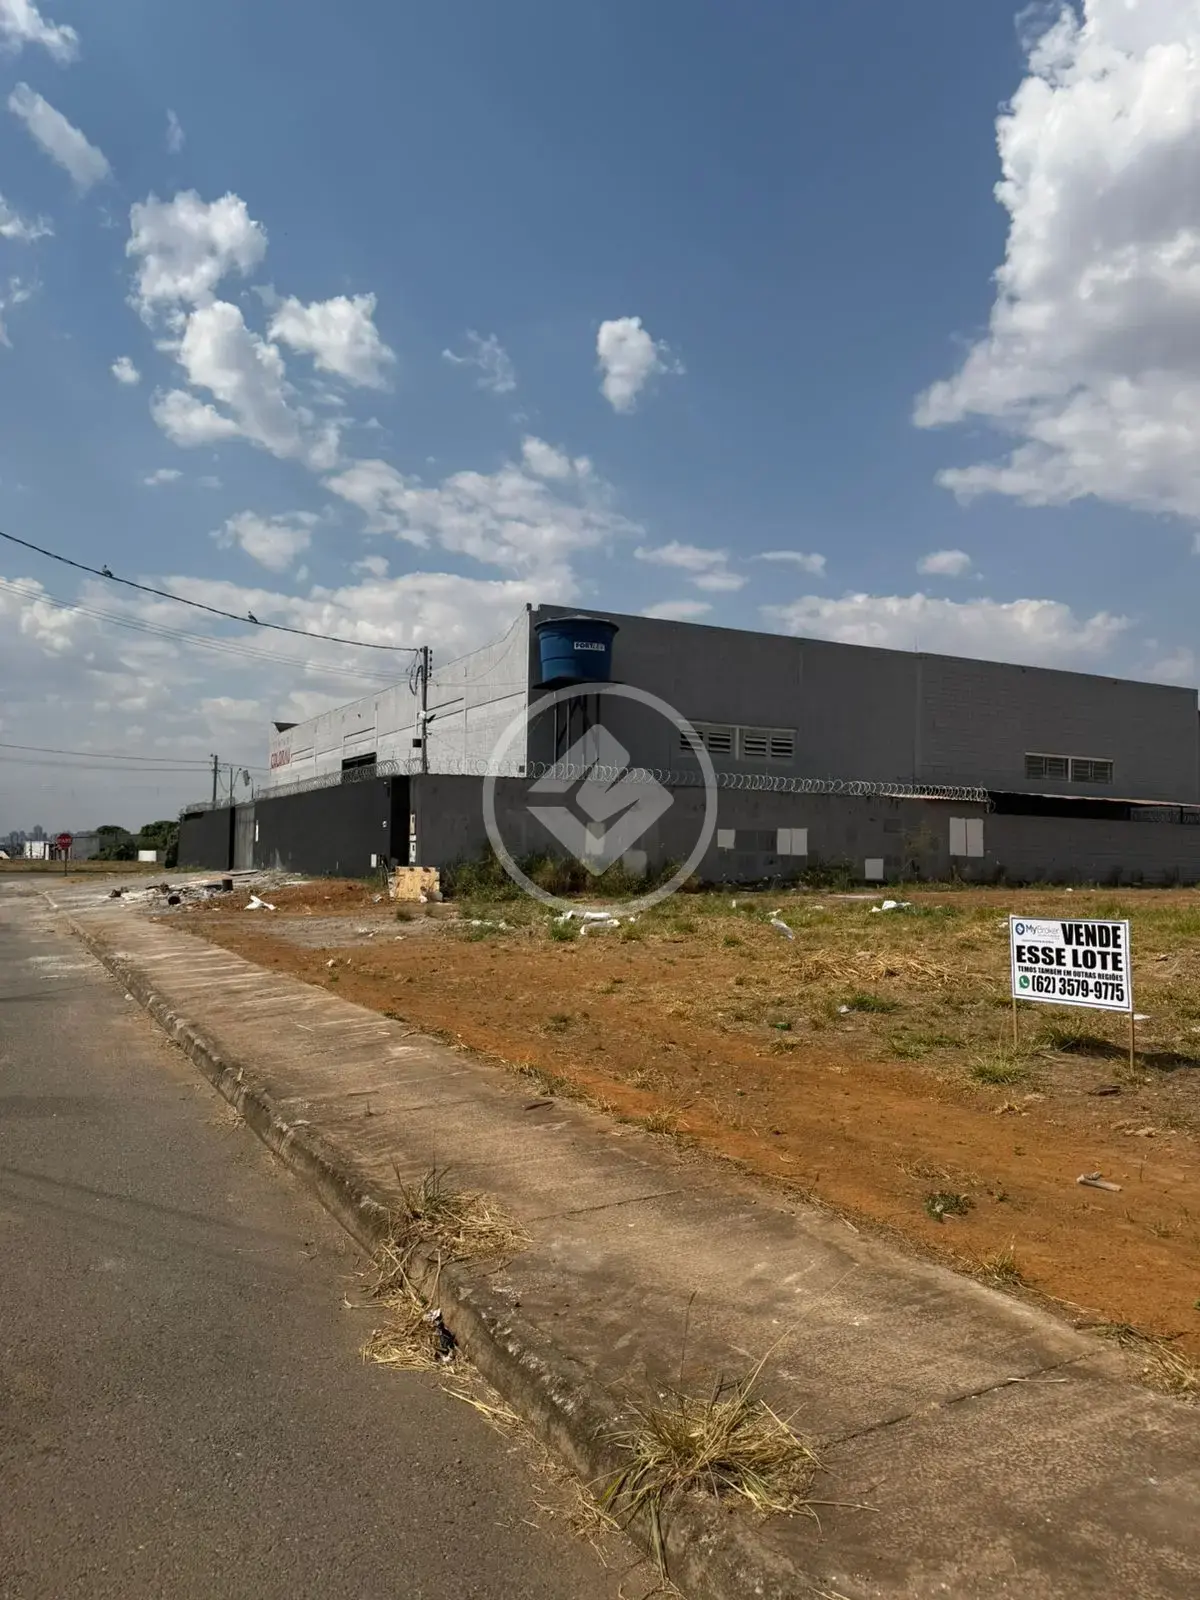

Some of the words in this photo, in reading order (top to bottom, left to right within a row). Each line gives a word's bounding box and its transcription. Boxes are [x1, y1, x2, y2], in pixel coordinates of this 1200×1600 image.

[1061, 923, 1122, 949] VENDE
[1016, 945, 1066, 966] ESSE
[1072, 949, 1123, 971] LOTE
[1018, 965, 1037, 973] TEMOS
[1038, 967, 1062, 976] TAMBÉM
[1072, 970, 1097, 979] OUTRAS
[1098, 972, 1123, 982] REGIÕES
[1032, 975, 1056, 994] (62)
[1059, 977, 1124, 1002] 3579-9775
